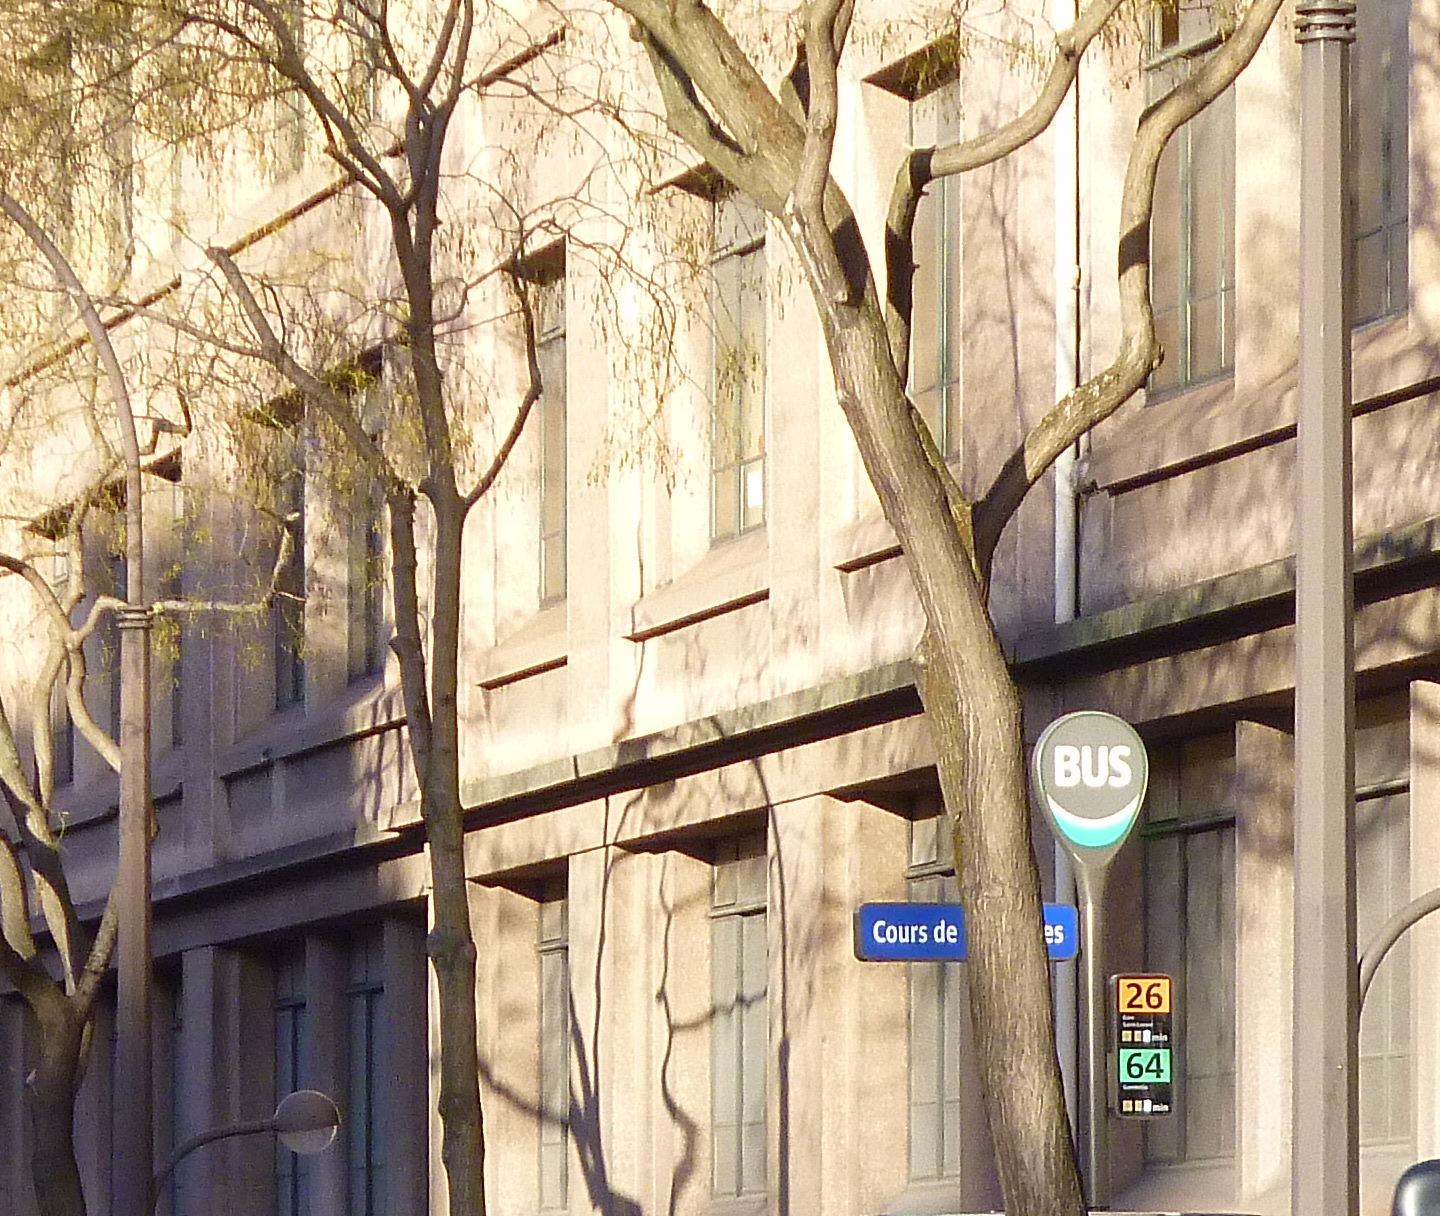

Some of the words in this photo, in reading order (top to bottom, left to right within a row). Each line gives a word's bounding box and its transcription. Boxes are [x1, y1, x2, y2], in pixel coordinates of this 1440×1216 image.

[1054, 744, 1132, 788] BUS
[872, 920, 928, 944] Cours
[933, 919, 958, 943] de
[1126, 982, 1163, 1010] 26
[1126, 1051, 1165, 1079] 64
